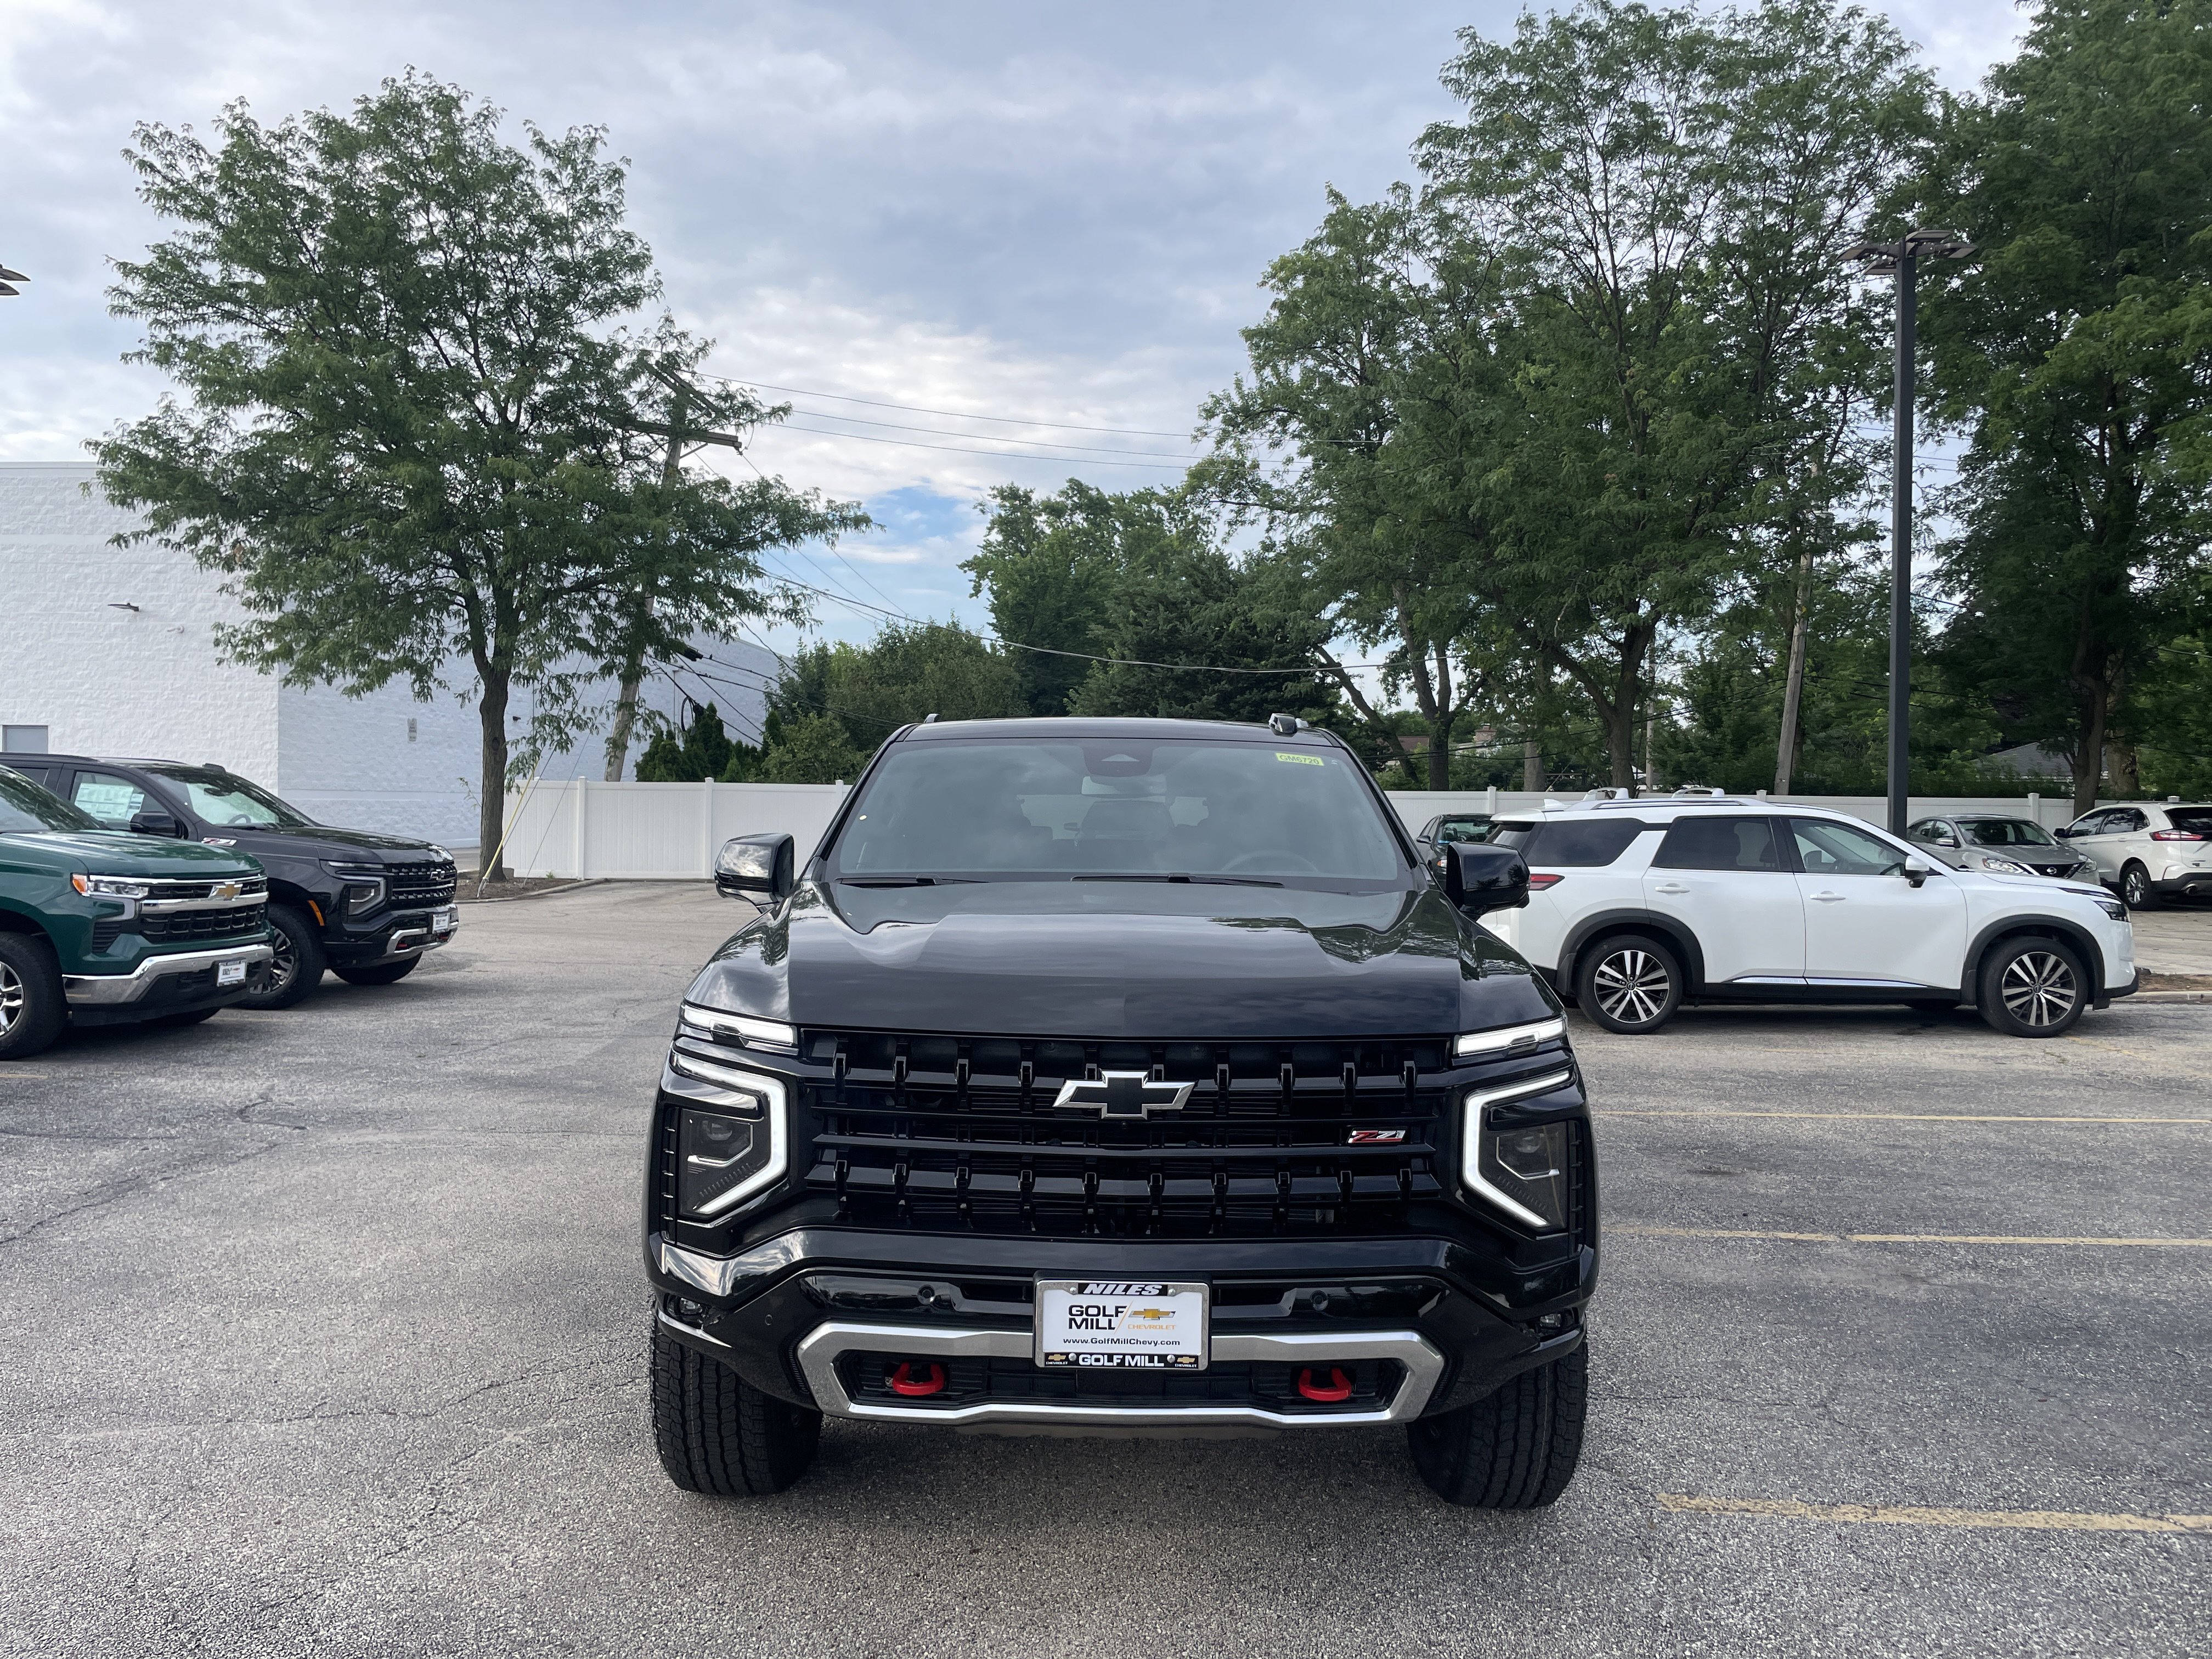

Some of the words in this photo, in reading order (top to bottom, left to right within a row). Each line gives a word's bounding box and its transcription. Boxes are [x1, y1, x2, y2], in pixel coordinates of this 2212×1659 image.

[1348, 1130, 1406, 1143] Z71
[1083, 1283, 1162, 1295] NILES
[1068, 1305, 1127, 1317] GOLF
[1068, 1318, 1116, 1330] MILL
[1063, 1338, 1180, 1346] www.GolfMillChevy.com
[1079, 1354, 1123, 1366] GOLF
[1125, 1355, 1165, 1367] MILL
